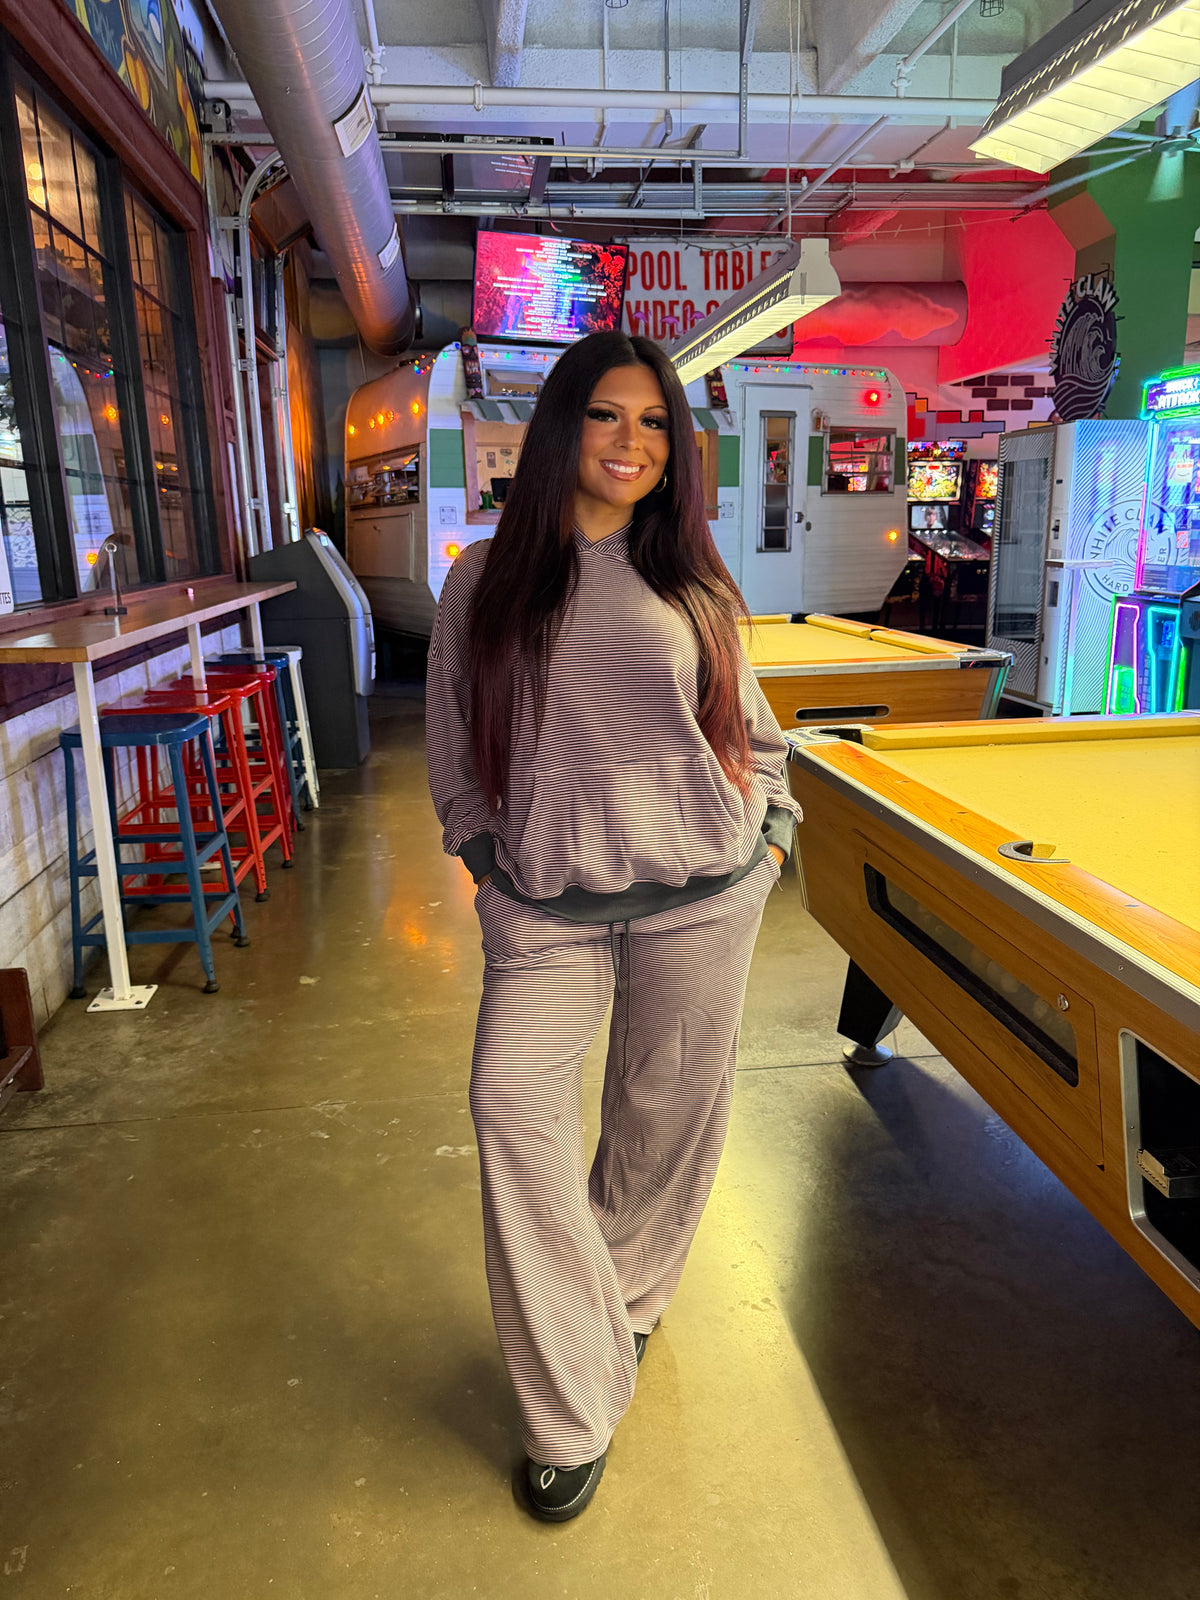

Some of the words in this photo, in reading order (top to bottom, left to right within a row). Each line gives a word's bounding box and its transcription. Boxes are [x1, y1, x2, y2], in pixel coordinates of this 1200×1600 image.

[624, 250, 688, 292] POOL
[702, 250, 784, 292] TABLE
[1049, 290, 1074, 376] WHITE
[1077, 273, 1117, 313] CLAW
[1157, 389, 1199, 409] ATTACK
[1102, 574, 1130, 592] HARD
